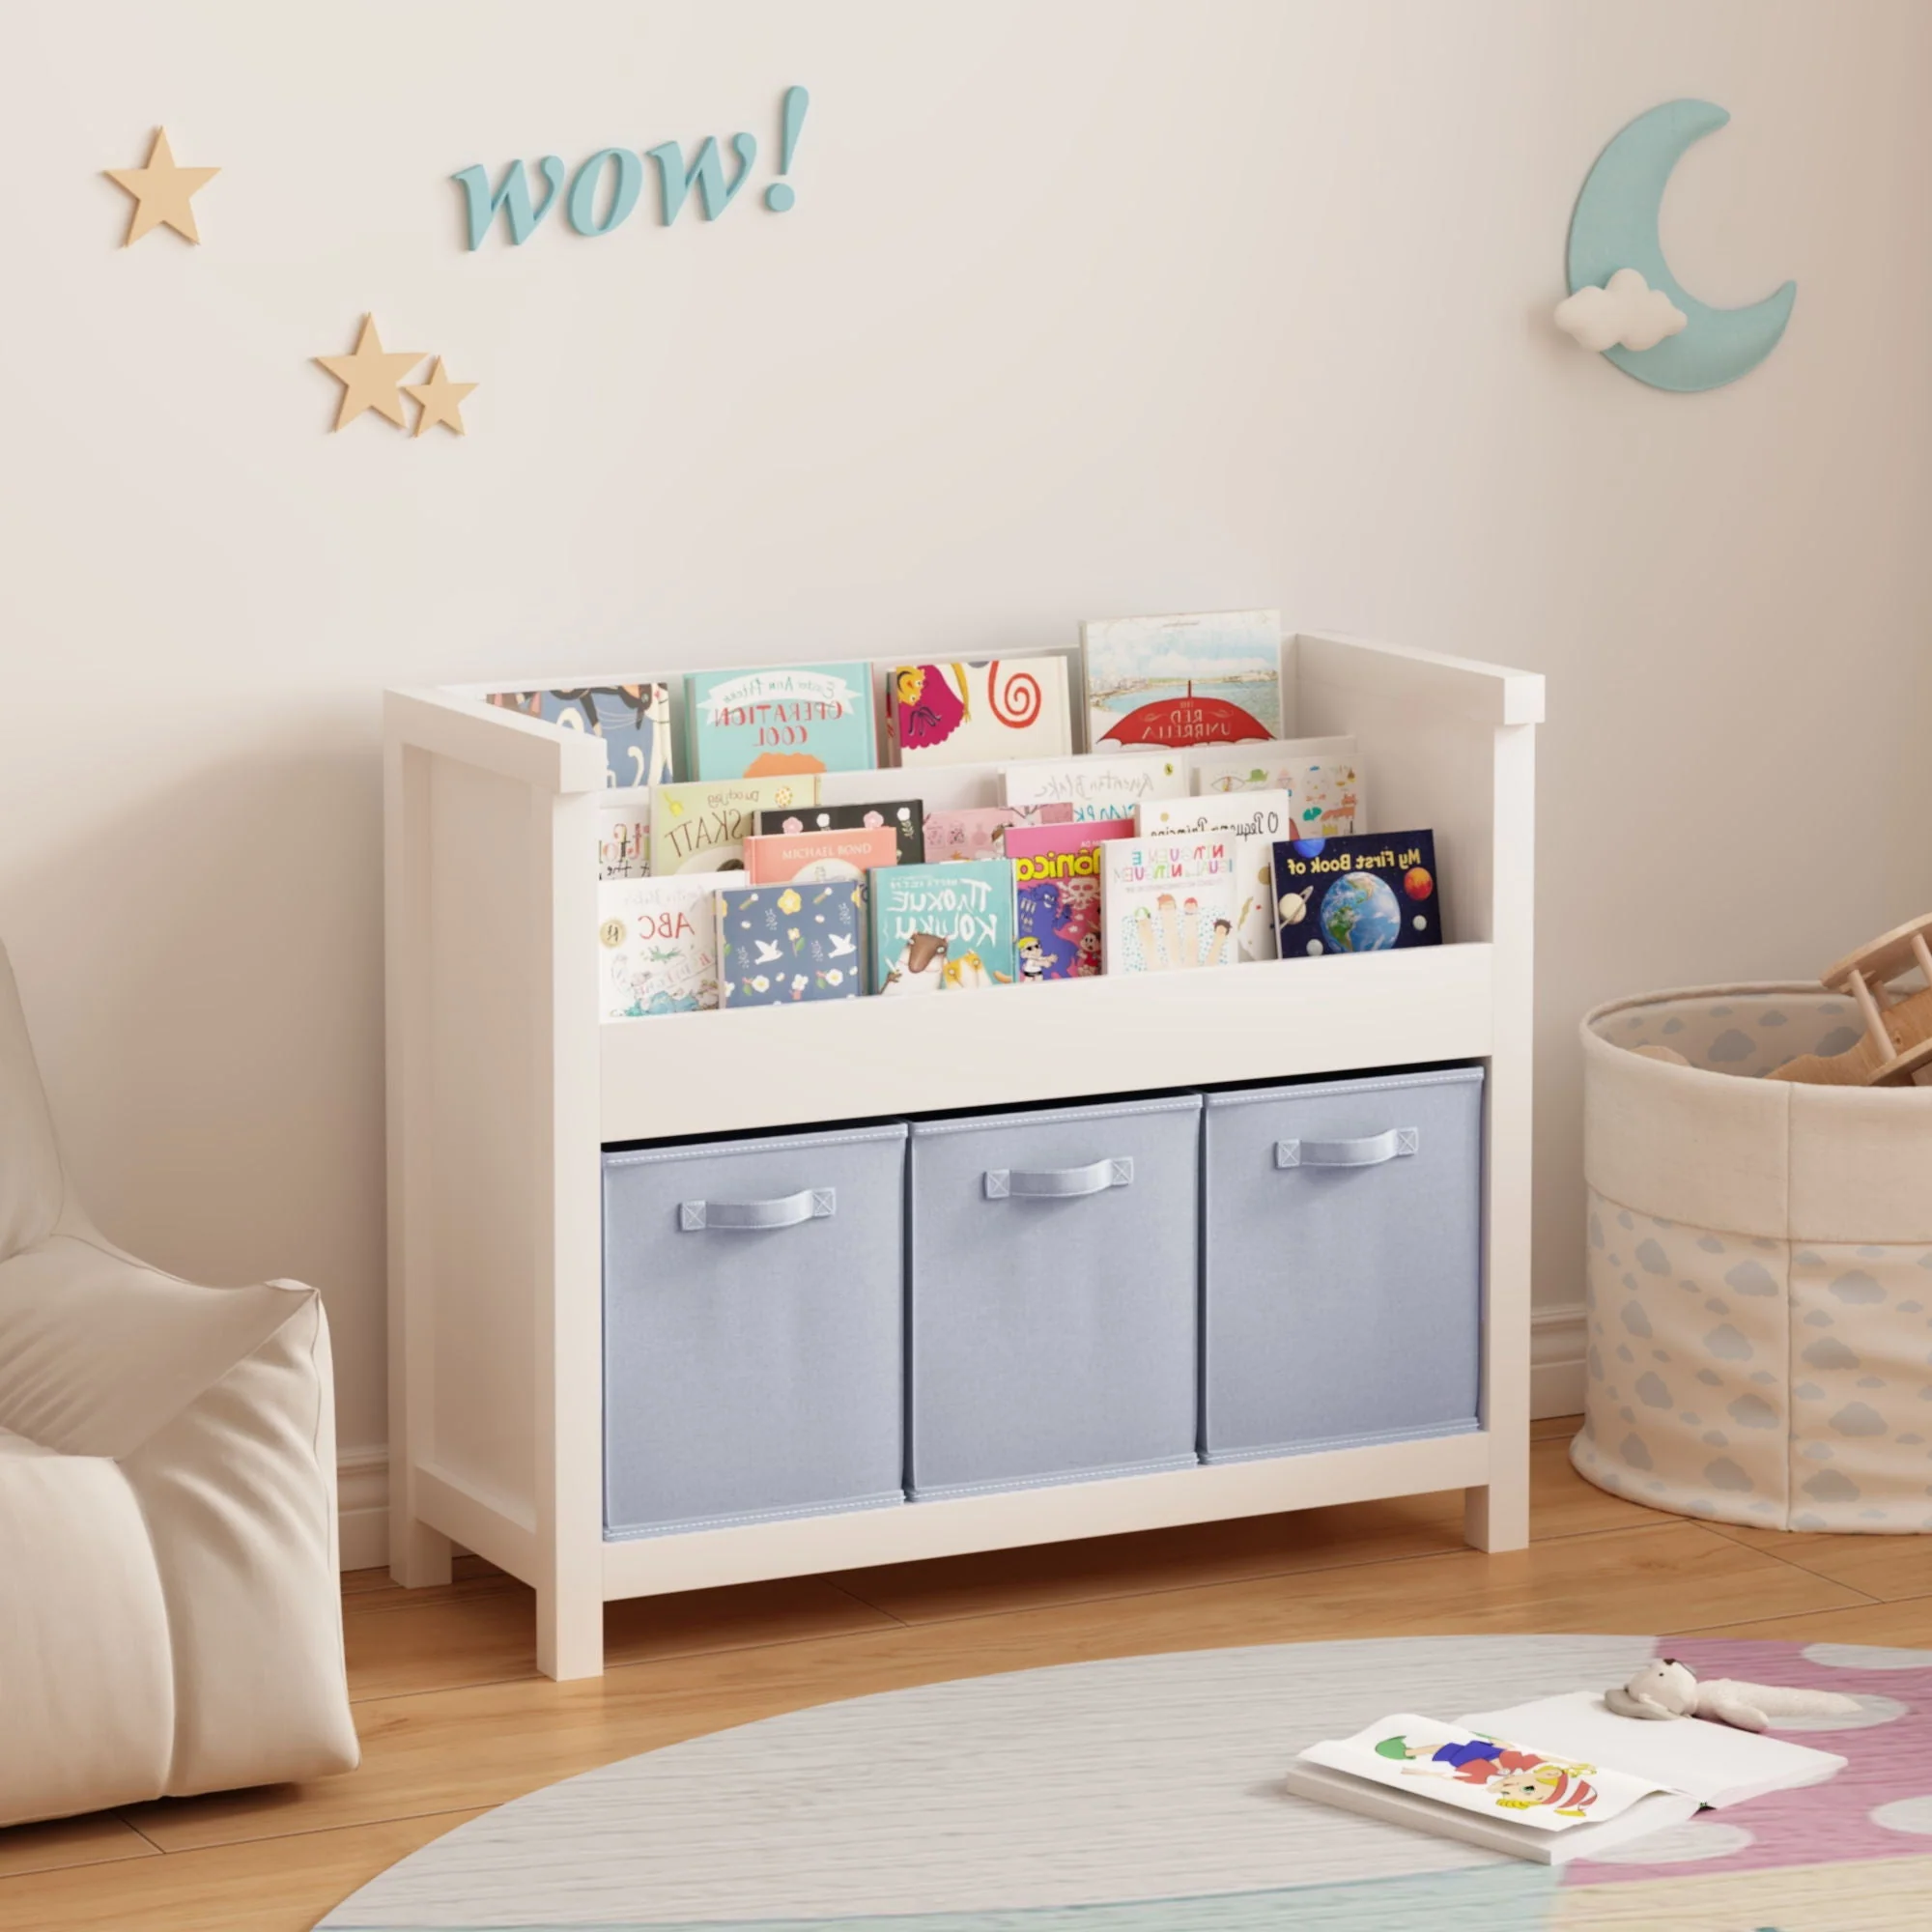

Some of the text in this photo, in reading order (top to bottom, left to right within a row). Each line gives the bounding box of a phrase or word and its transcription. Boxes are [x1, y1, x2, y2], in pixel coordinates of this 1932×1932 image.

[449, 84, 810, 252] wow!
[781, 842, 872, 860] MICHAEL BOND
